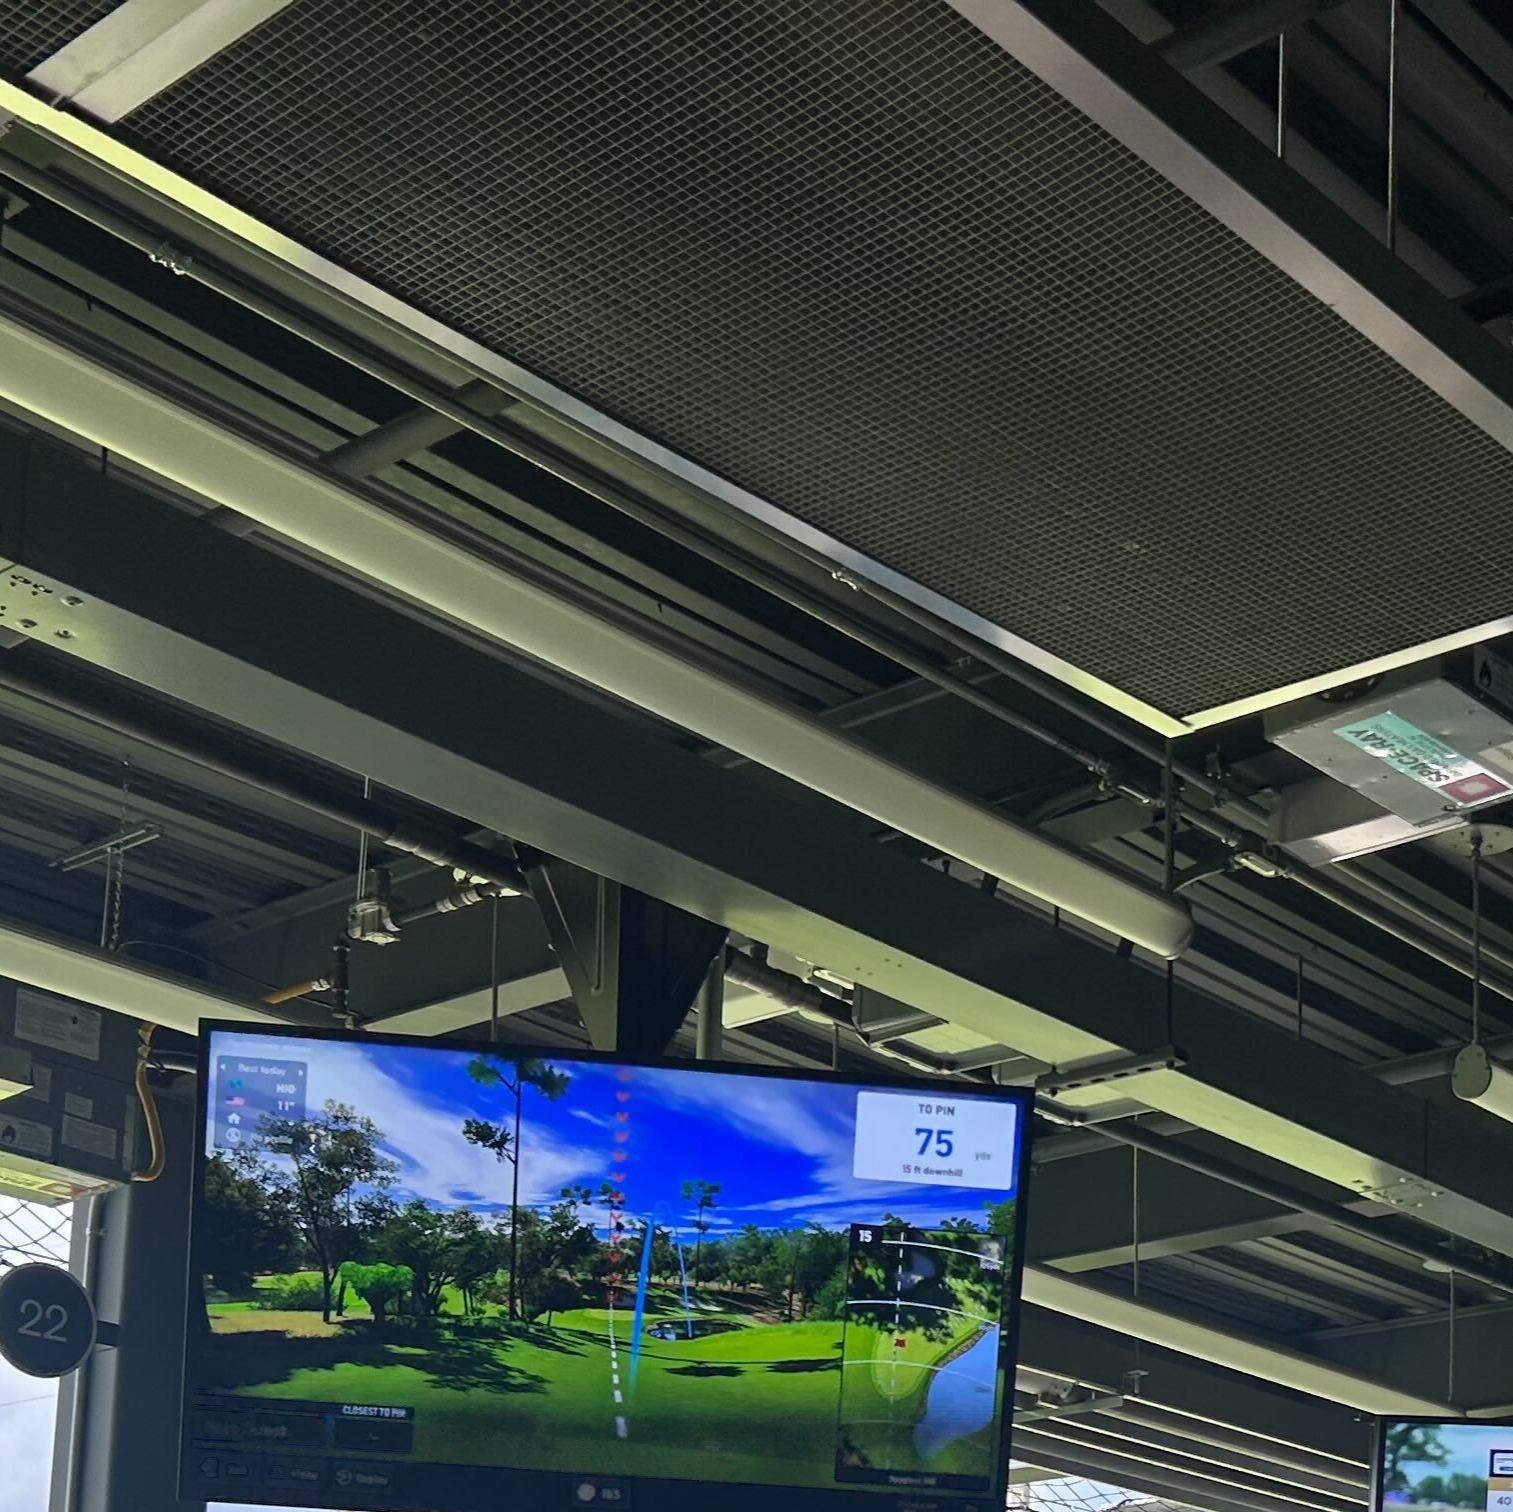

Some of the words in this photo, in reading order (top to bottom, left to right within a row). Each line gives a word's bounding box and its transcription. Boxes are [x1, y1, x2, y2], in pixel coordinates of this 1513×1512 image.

[919, 1104, 932, 1114] TO
[936, 1106, 955, 1116] PIN
[915, 1128, 954, 1157] 75
[17, 1299, 69, 1343] 22
[343, 1405, 378, 1416] CLOSEST
[1497, 1497, 1512, 1506] 40
